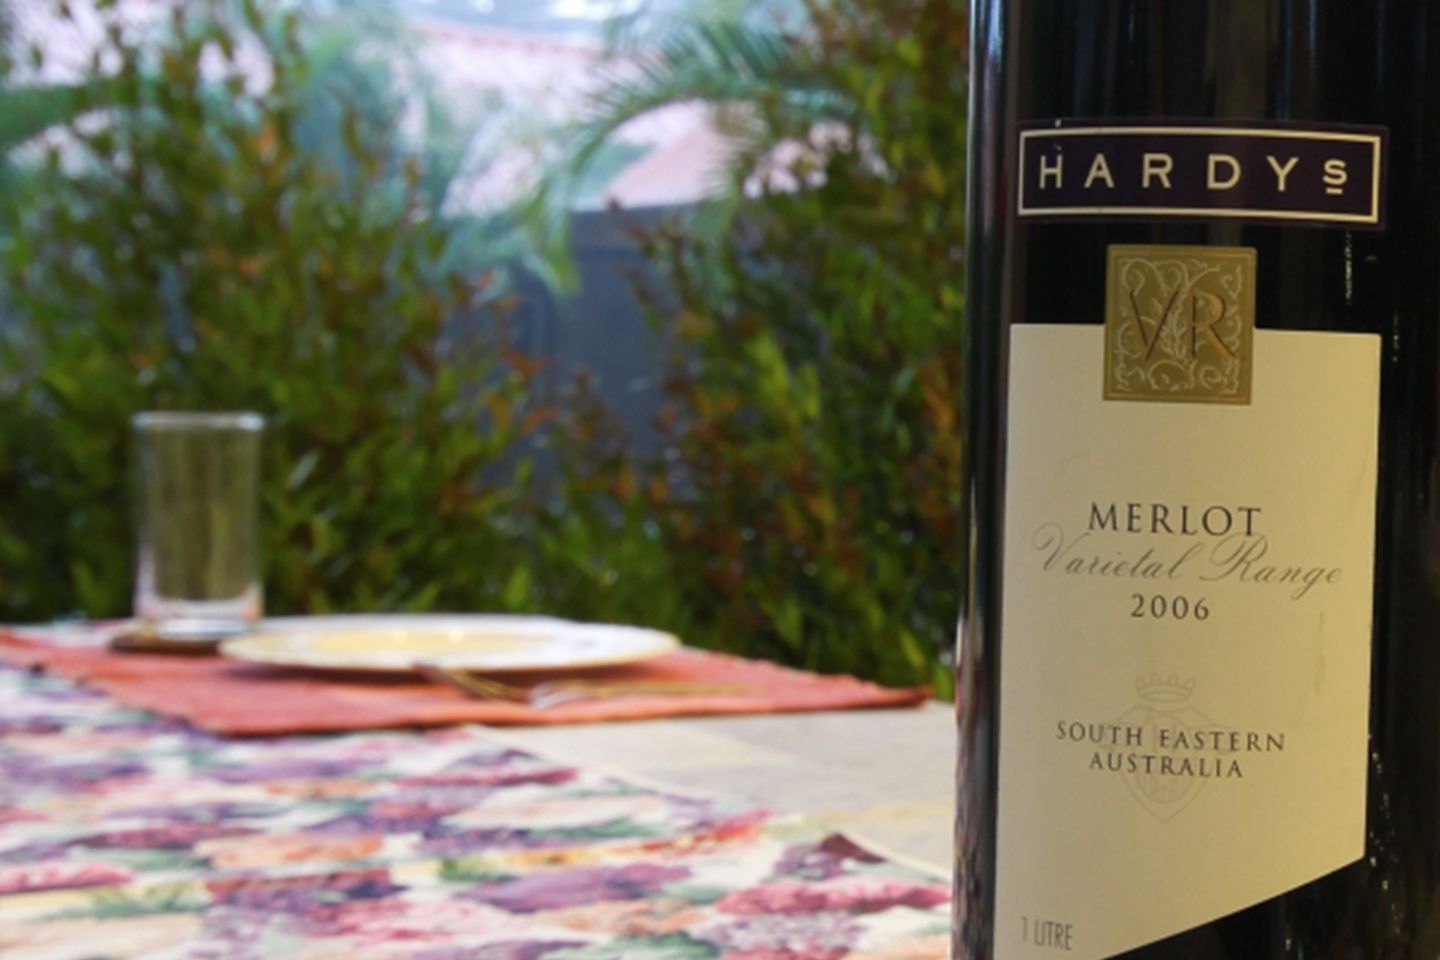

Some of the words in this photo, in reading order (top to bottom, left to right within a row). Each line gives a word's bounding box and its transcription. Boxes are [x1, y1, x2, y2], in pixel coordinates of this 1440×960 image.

[1038, 152, 1348, 195] HARDYS
[1086, 501, 1262, 538] MERLOT
[1031, 522, 1203, 580] Varietal
[1199, 532, 1343, 601] Range
[1130, 593, 1210, 621] 2006
[1056, 719, 1143, 747] SOUTH
[1159, 729, 1285, 752] EASTERN
[1089, 752, 1243, 779] AUSTRALIA
[1021, 915, 1029, 943] 1
